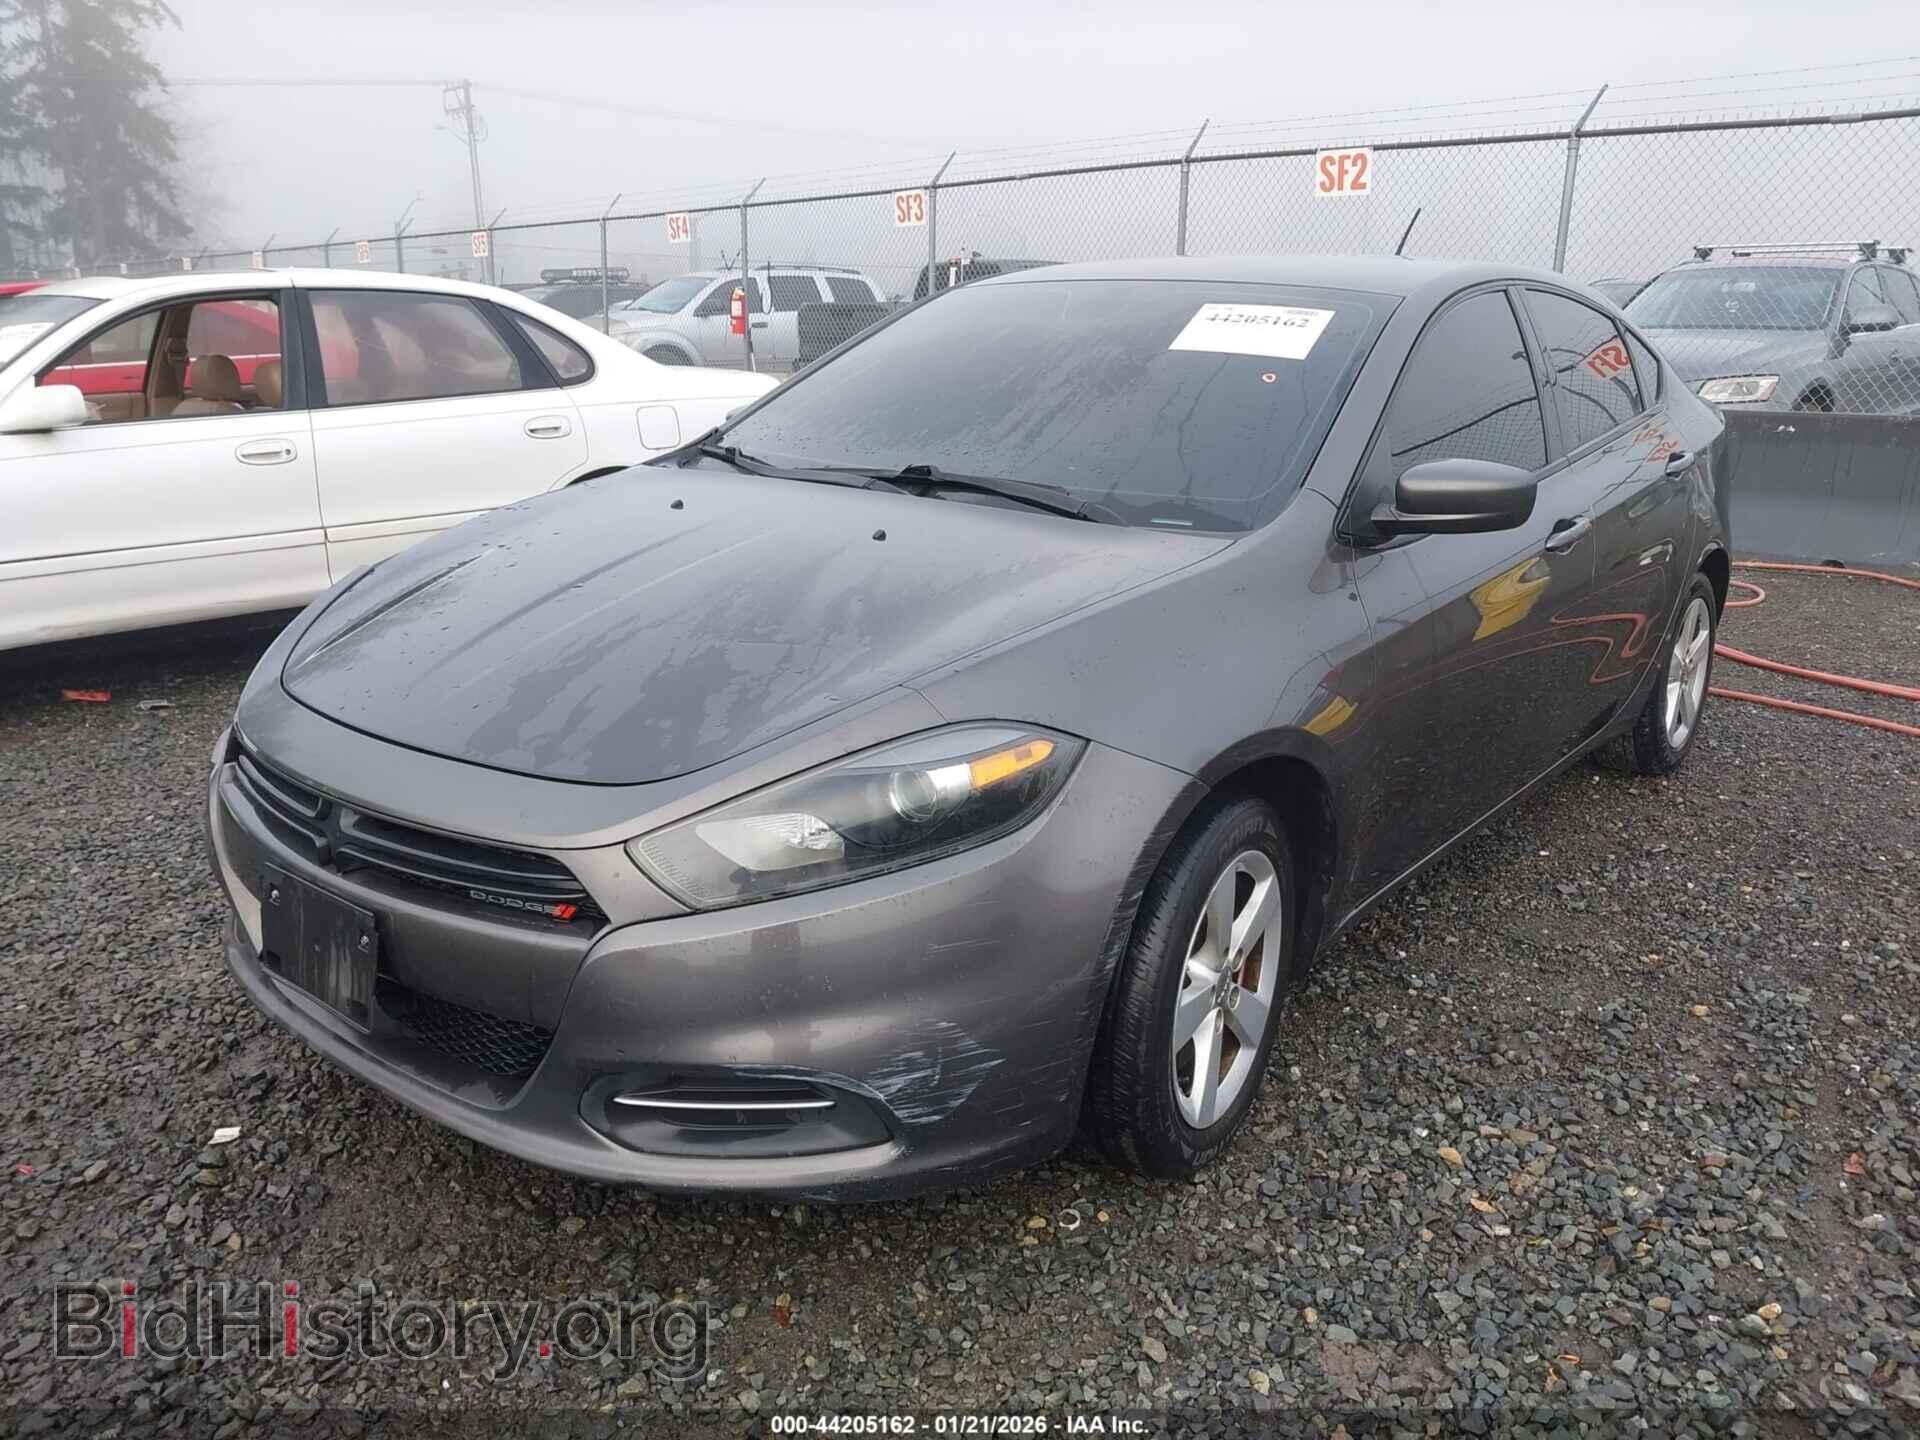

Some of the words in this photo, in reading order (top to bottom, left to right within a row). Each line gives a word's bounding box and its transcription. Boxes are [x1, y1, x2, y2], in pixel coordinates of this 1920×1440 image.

[1319, 153, 1369, 193] SF2
[896, 193, 925, 224] SF3
[668, 215, 689, 240] SF4
[1204, 312, 1310, 328] 44205162
[469, 889, 559, 915] DODGE
